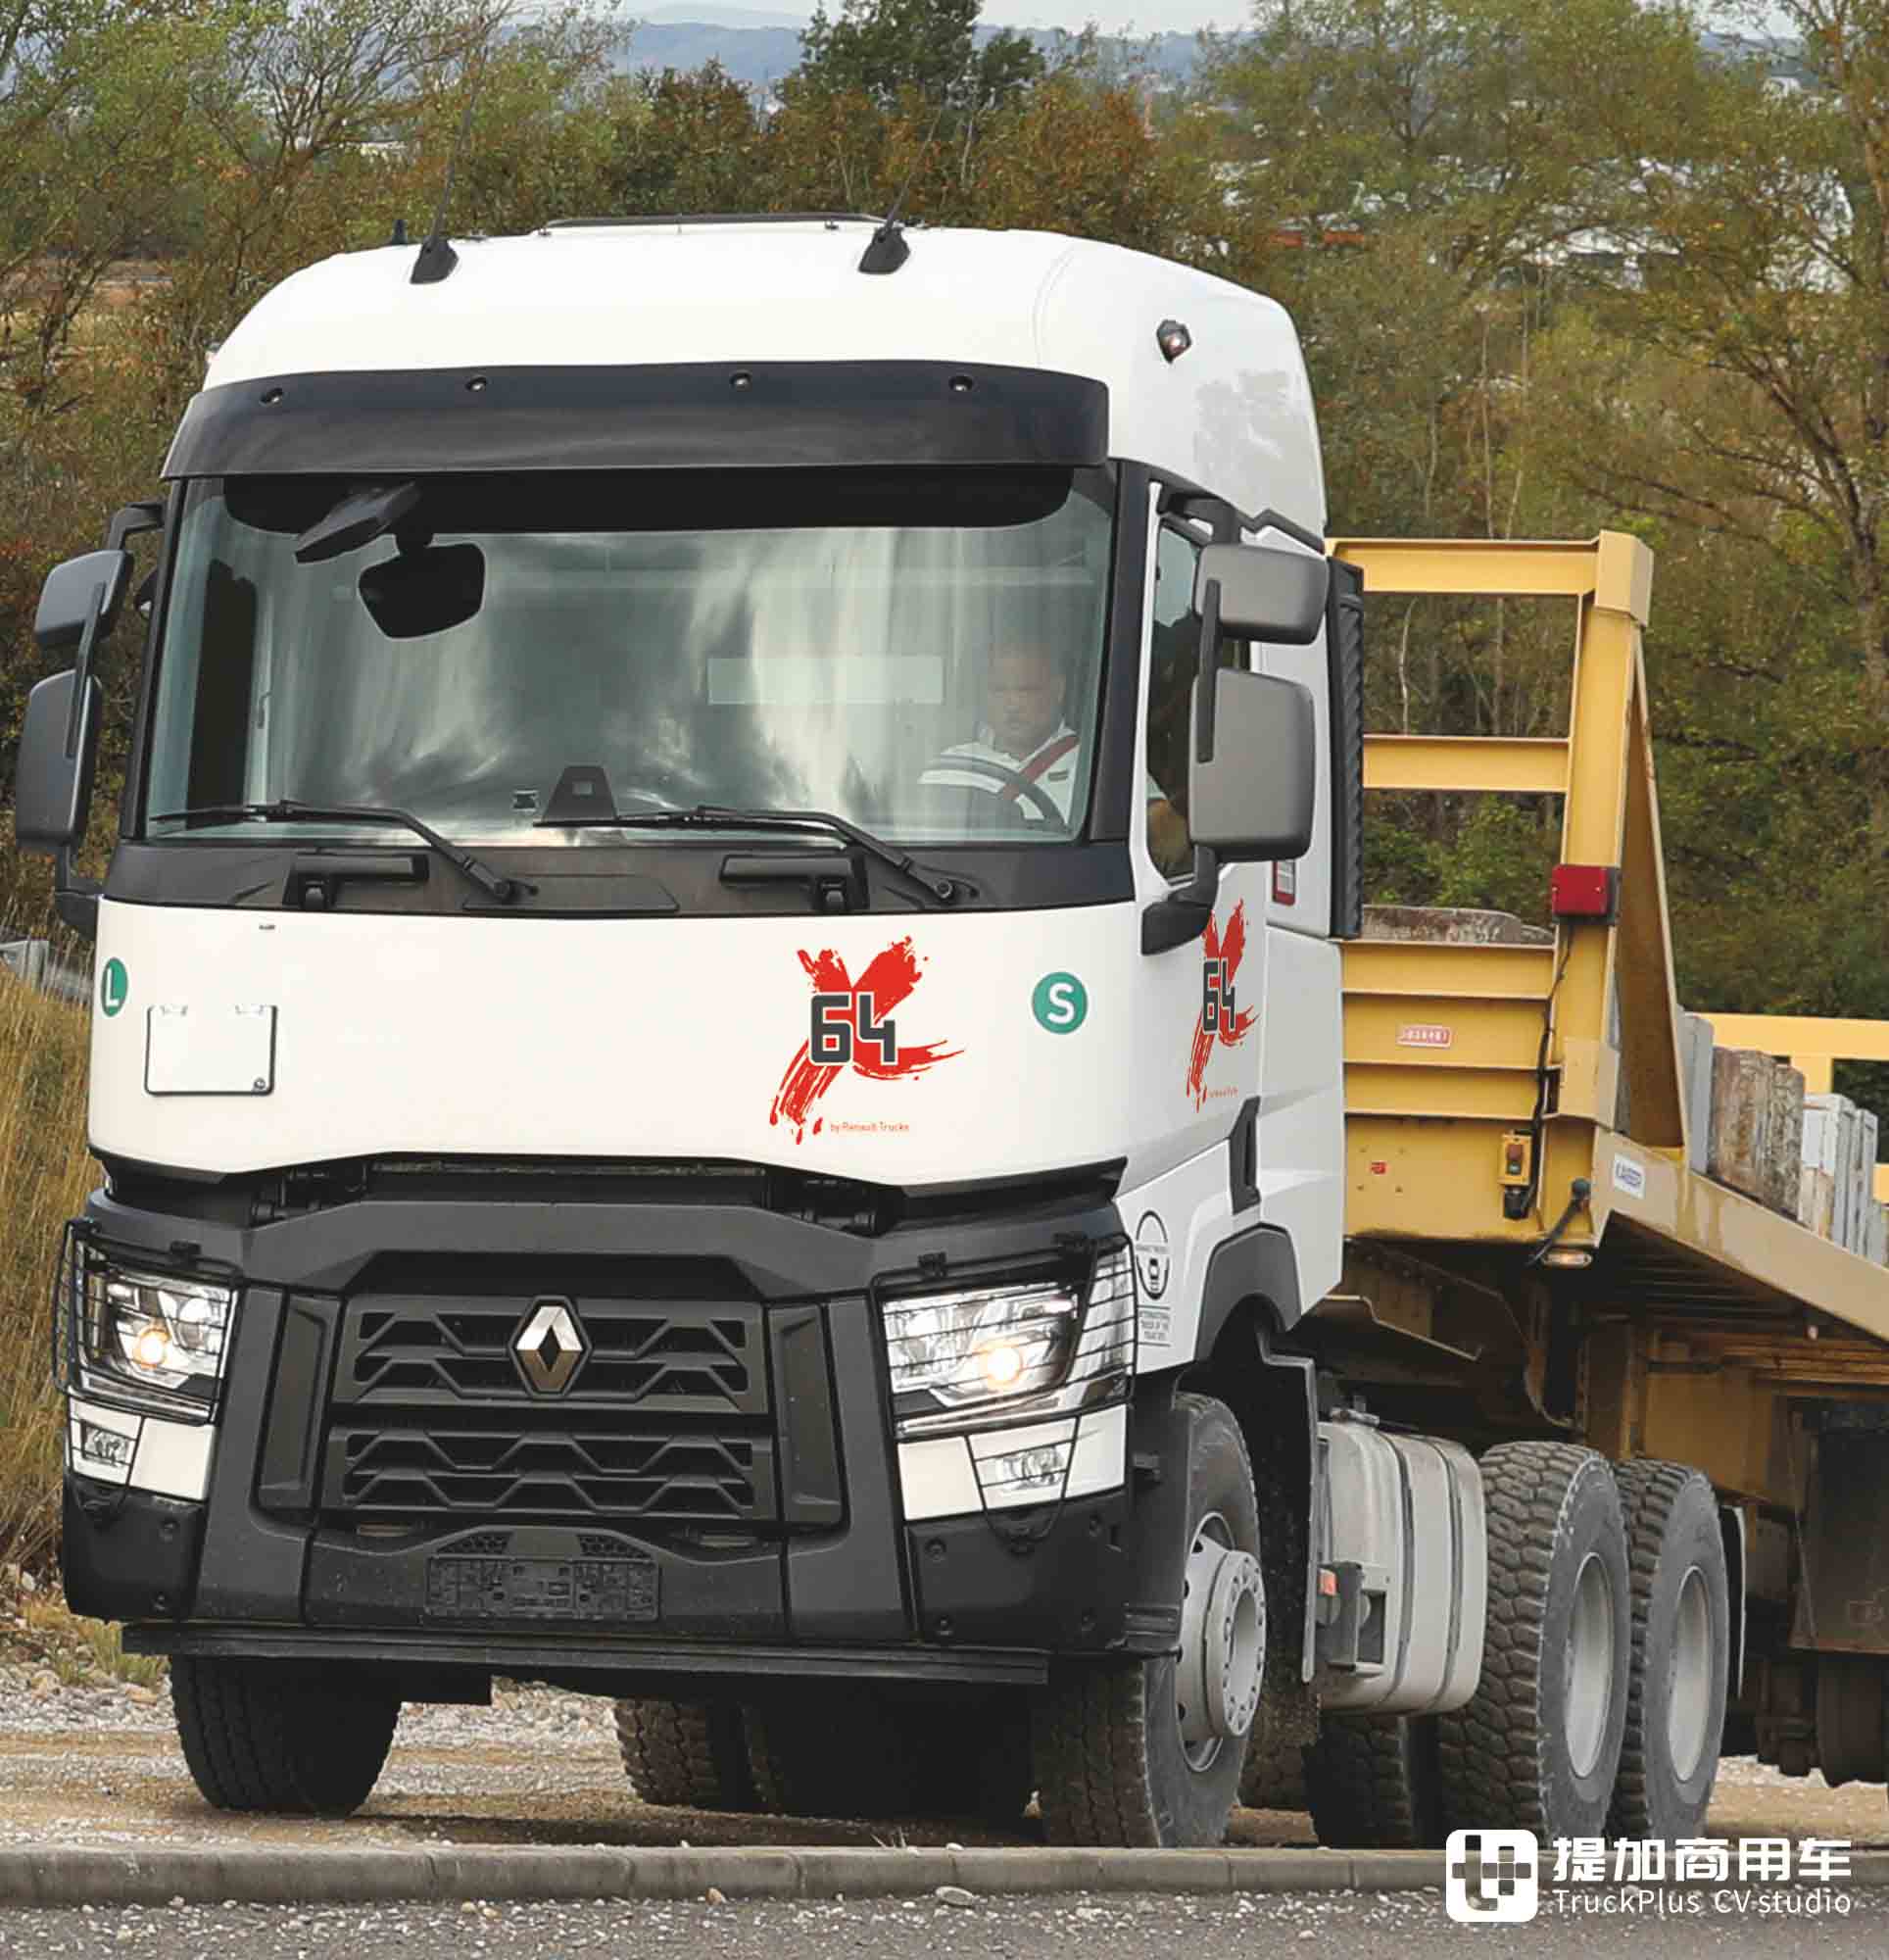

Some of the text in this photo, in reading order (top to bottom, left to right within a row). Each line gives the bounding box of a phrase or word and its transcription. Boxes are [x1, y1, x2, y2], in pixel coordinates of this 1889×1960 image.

[106, 966, 121, 1007] L
[1047, 982, 1075, 1024] S
[1203, 958, 1236, 1034] 64
[810, 993, 897, 1065] 64
